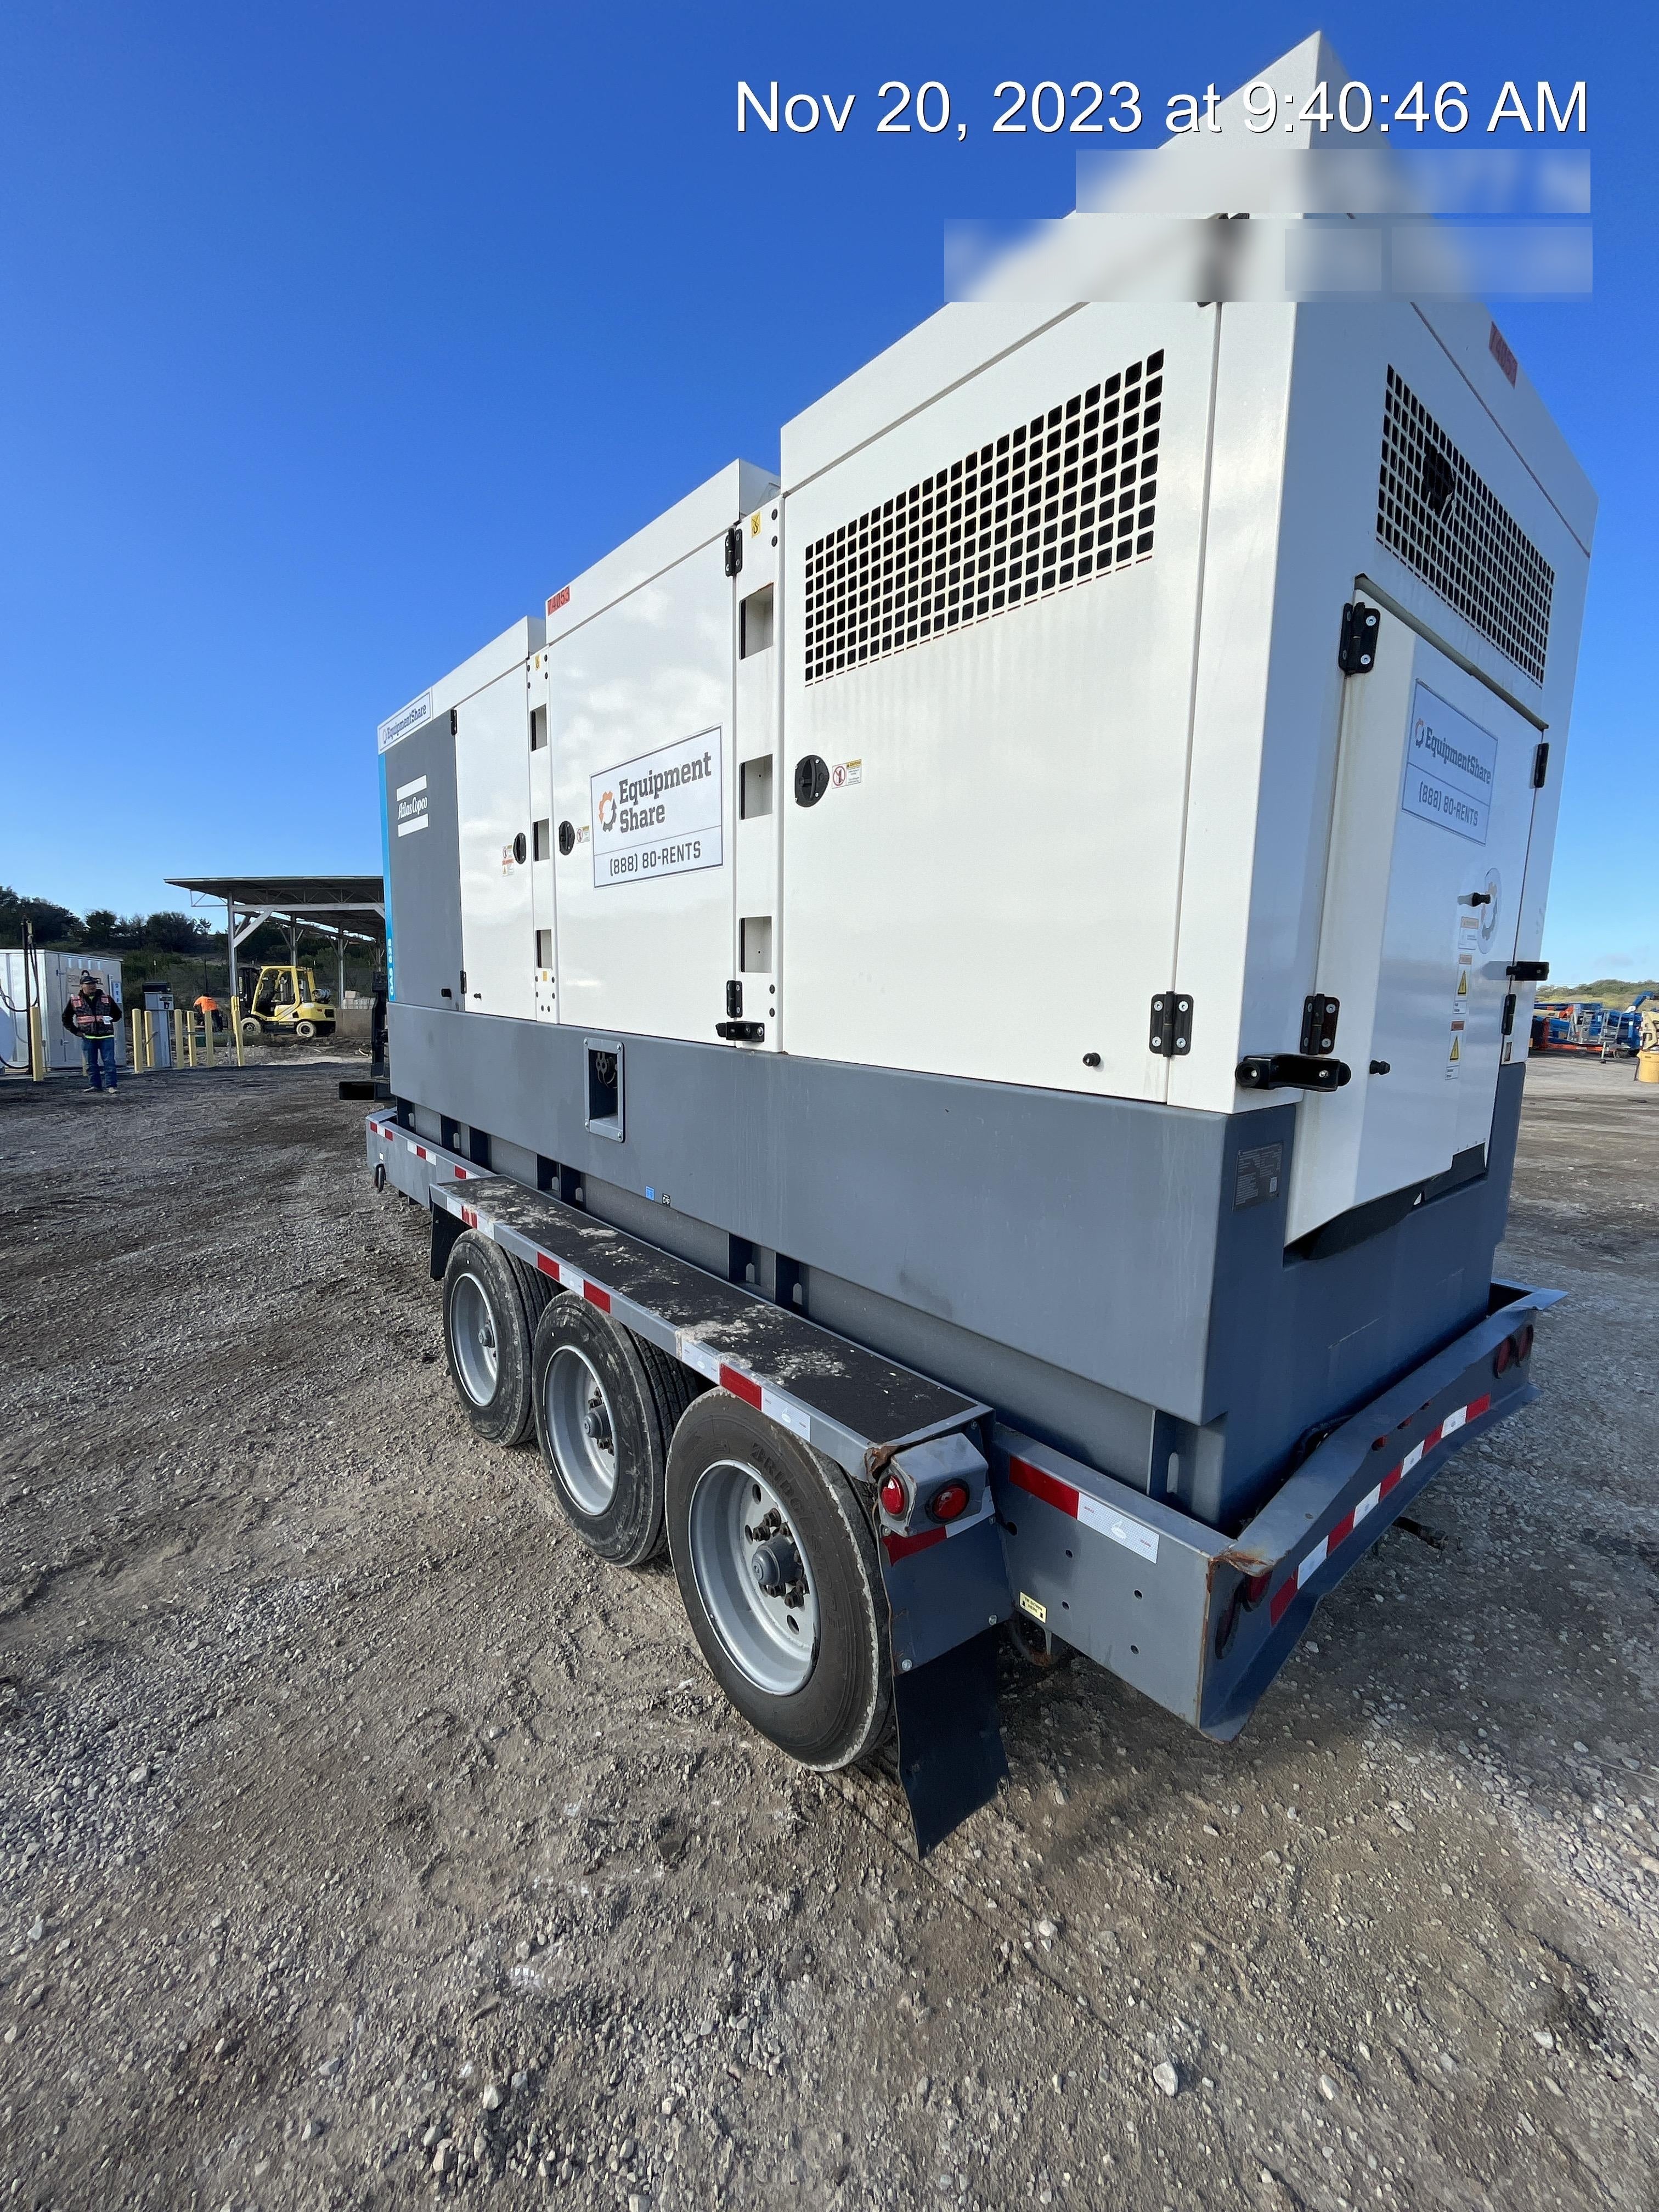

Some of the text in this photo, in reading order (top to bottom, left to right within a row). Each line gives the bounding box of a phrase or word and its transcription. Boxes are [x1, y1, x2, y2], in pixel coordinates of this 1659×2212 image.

[387, 704, 426, 740] EquipmentShare
[1425, 726, 1491, 785] EquipmentShare
[619, 752, 712, 805] Equipment
[398, 797, 427, 820] Atlas Copco
[620, 804, 665, 833] Share
[1419, 781, 1479, 826] (888) 80-RENTS
[610, 840, 701, 877] (888) 80-RENTS
